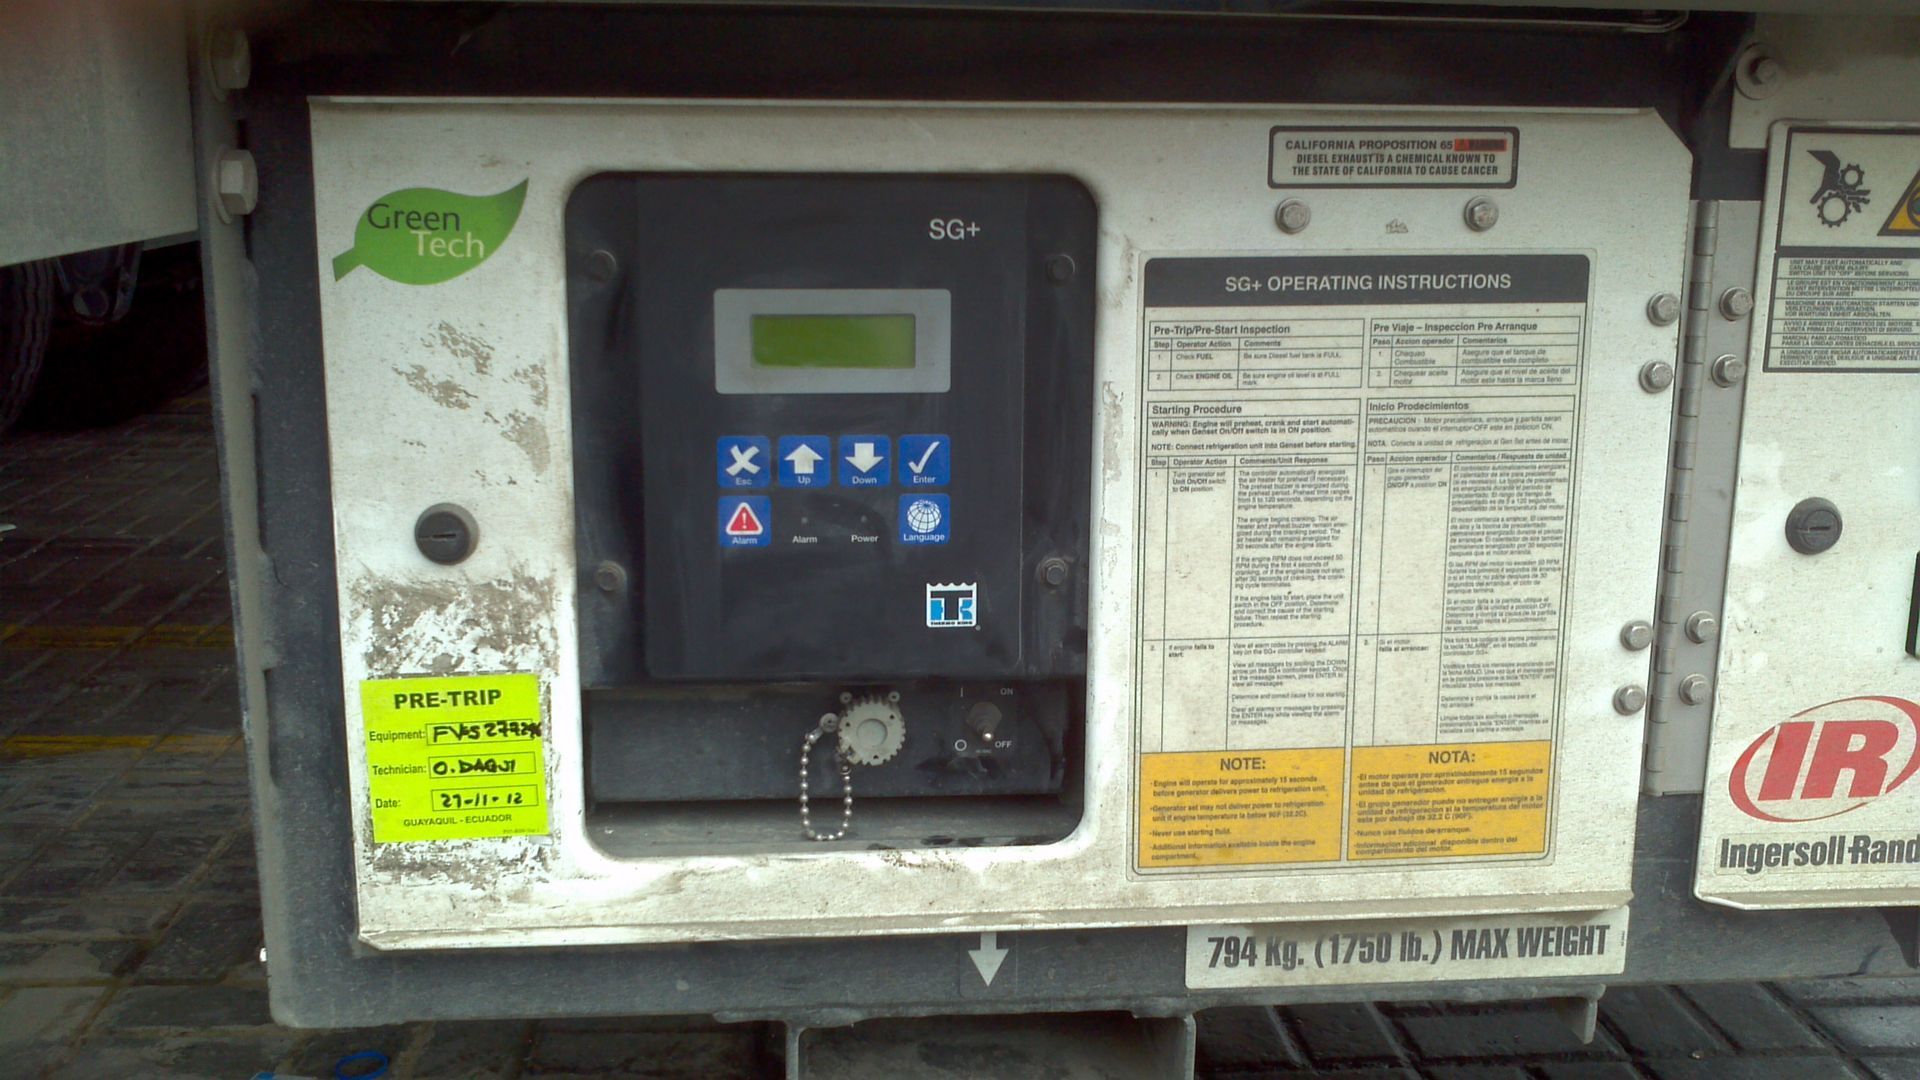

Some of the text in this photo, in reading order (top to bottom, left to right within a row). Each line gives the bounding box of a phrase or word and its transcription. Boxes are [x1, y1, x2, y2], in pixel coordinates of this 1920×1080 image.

[1285, 140, 1452, 150] CALIFORNIA PROPOSITION 65
[1297, 154, 1495, 164] DIESEL EXHAUST IS A CHEMICAL KNOWN TO
[1292, 166, 1498, 175] THE STATE OF CALIFORNIA TO CAUSE CANCER
[367, 203, 460, 232] Green
[928, 219, 981, 240] SG+
[410, 230, 485, 259] Tech
[1225, 273, 1512, 292] SG+ OPERATING INSTRUCTIONS
[1154, 325, 1290, 336] Pre-Trip/Pre-Start Inspection
[1373, 324, 1389, 332] Pre
[1392, 323, 1414, 333] Viaje
[1425, 323, 1475, 333] Inspeccion
[1478, 323, 1493, 331] Pre
[1496, 322, 1538, 332] Arranque
[1154, 341, 1170, 349] Step
[1176, 341, 1206, 349] Operator
[1422, 337, 1454, 346] operador
[1152, 405, 1242, 415] Starting Procedure
[1369, 402, 1469, 411] Inicio Prodecimientos
[1193, 421, 1218, 429] Engine
[1234, 420, 1262, 428] preheat,
[1152, 429, 1168, 437] cally
[1301, 427, 1331, 435] position.
[1206, 443, 1247, 451] refrigeration
[1329, 441, 1356, 450] starting.
[1173, 459, 1203, 467] Operator
[1294, 457, 1328, 465] Response
[1416, 455, 1448, 463] operador
[735, 477, 753, 486] Esc
[797, 476, 811, 485] Up
[851, 476, 877, 484] Down
[913, 475, 936, 484] Enter
[732, 536, 758, 545] Alarm
[792, 535, 817, 544] Alarm
[851, 534, 878, 543] Power
[903, 533, 945, 542] Language
[1000, 688, 1014, 696] ON
[394, 689, 502, 710] PRE-TRIP
[369, 729, 426, 743] Equipment:
[995, 740, 1012, 749] OFF
[1428, 751, 1476, 764] NOTA:
[1757, 720, 1899, 802] IR
[1220, 757, 1266, 771] NOTE:
[373, 764, 426, 776] Technician:
[375, 798, 401, 809] Date:
[403, 817, 457, 827] GUAYAQUIL
[465, 814, 512, 823] ECUADOR
[1207, 936, 1257, 968] 794
[1265, 934, 1304, 974] Kg.
[1315, 932, 1391, 972] (1750
[1400, 930, 1441, 969] lb.)
[1451, 928, 1508, 960] MAX
[1517, 925, 1610, 957] WEIGHT
